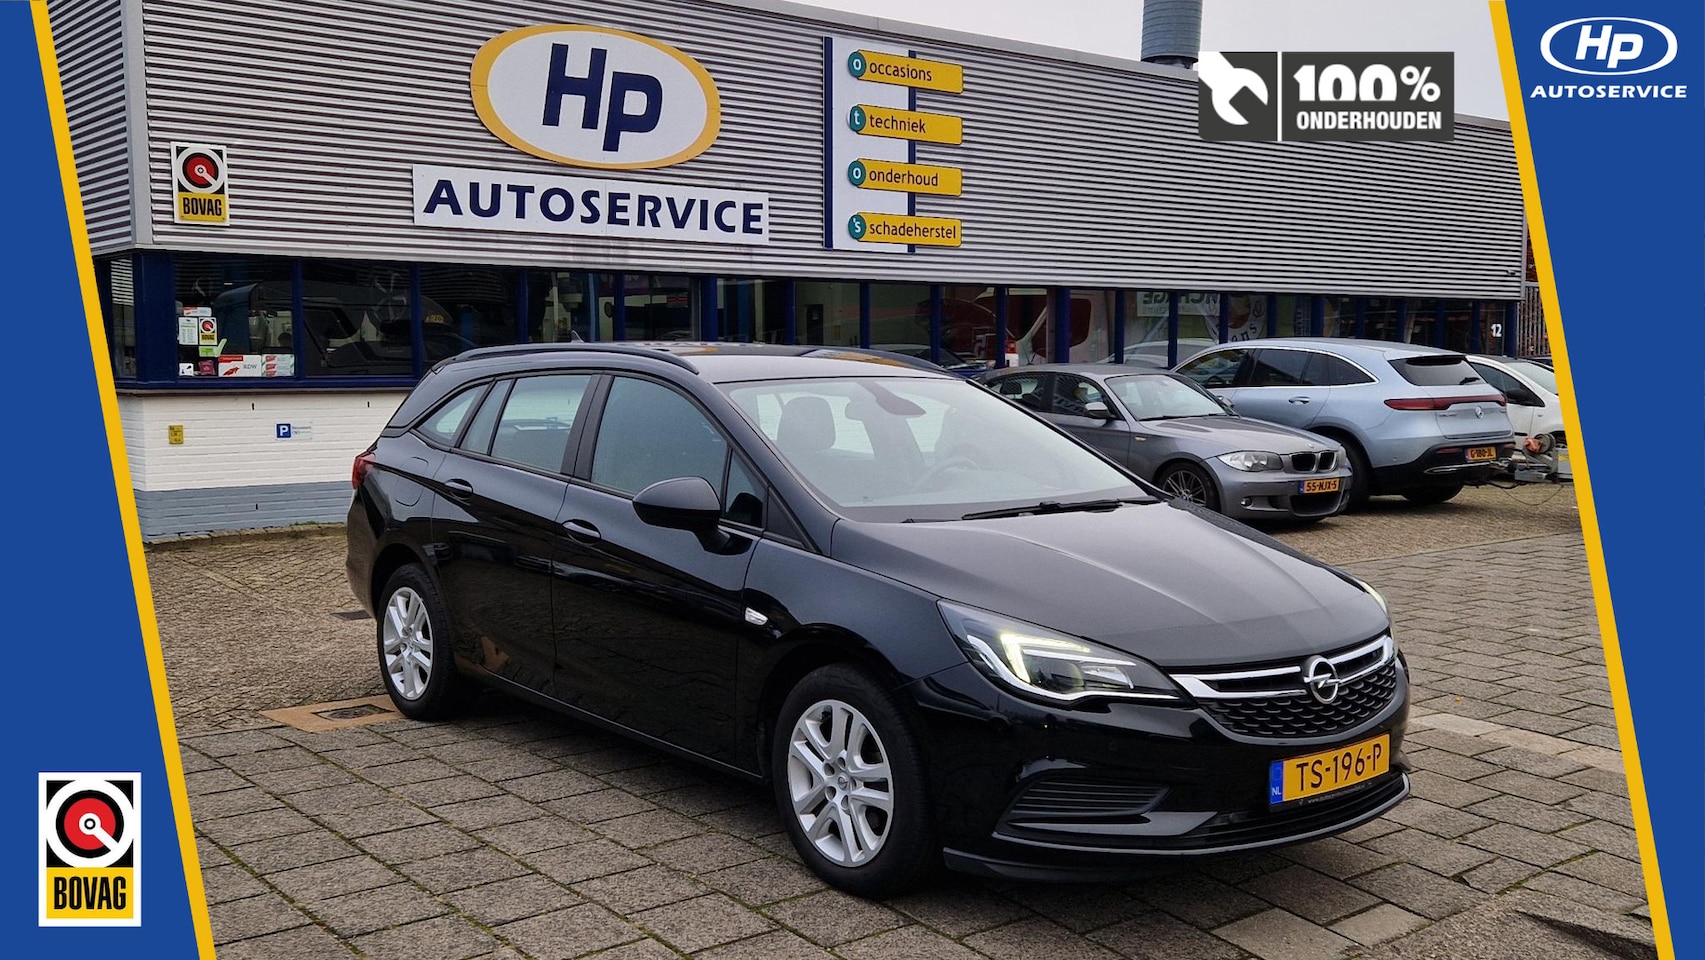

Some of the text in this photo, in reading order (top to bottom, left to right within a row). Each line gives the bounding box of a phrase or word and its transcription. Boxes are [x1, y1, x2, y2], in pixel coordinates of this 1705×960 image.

[869, 62, 932, 82] occasions
[869, 114, 926, 134] techniek
[869, 168, 939, 187] onderhoud
[182, 196, 223, 217] BOVAG
[423, 179, 764, 236] AUTOSERVICE
[869, 221, 957, 239] schadeherstel
[1491, 323, 1502, 337] 12
[279, 425, 289, 437] P
[1306, 480, 1337, 492] 55-NJX-5
[1271, 786, 1283, 797] NL
[1296, 743, 1382, 792] TS-196-P
